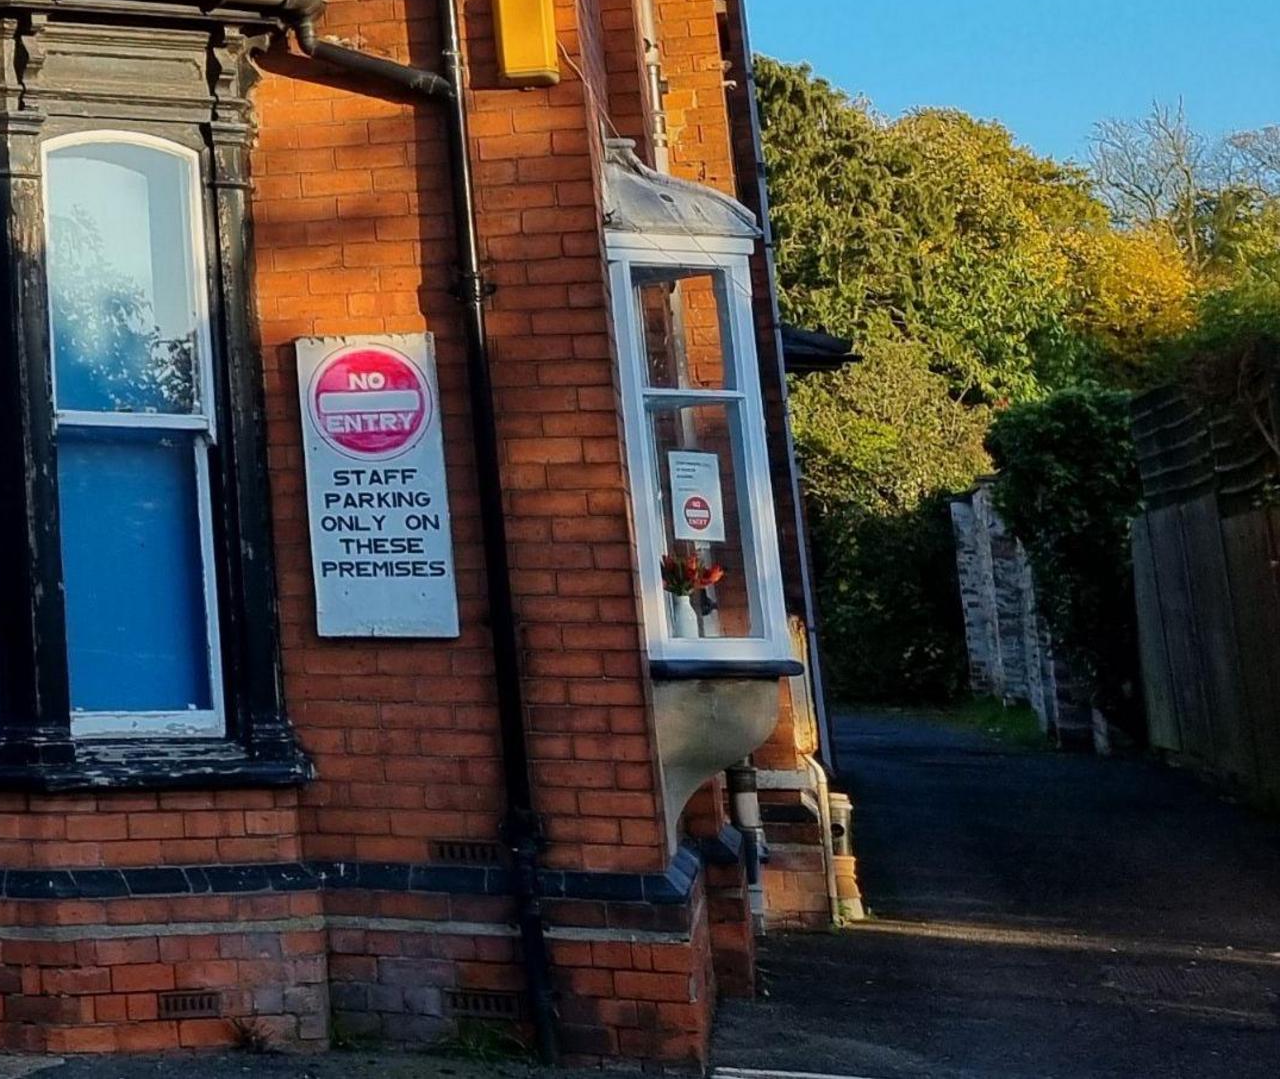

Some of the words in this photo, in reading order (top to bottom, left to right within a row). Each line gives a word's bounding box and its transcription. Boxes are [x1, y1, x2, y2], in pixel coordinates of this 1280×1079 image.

[348, 372, 385, 390] NO
[326, 412, 414, 433] ENTRY
[333, 469, 417, 486] STAFF
[324, 491, 431, 509] PARKING
[321, 515, 386, 531] ONLY
[405, 514, 440, 530] ON
[340, 538, 424, 554] THESE
[321, 561, 445, 578] PREMISES
